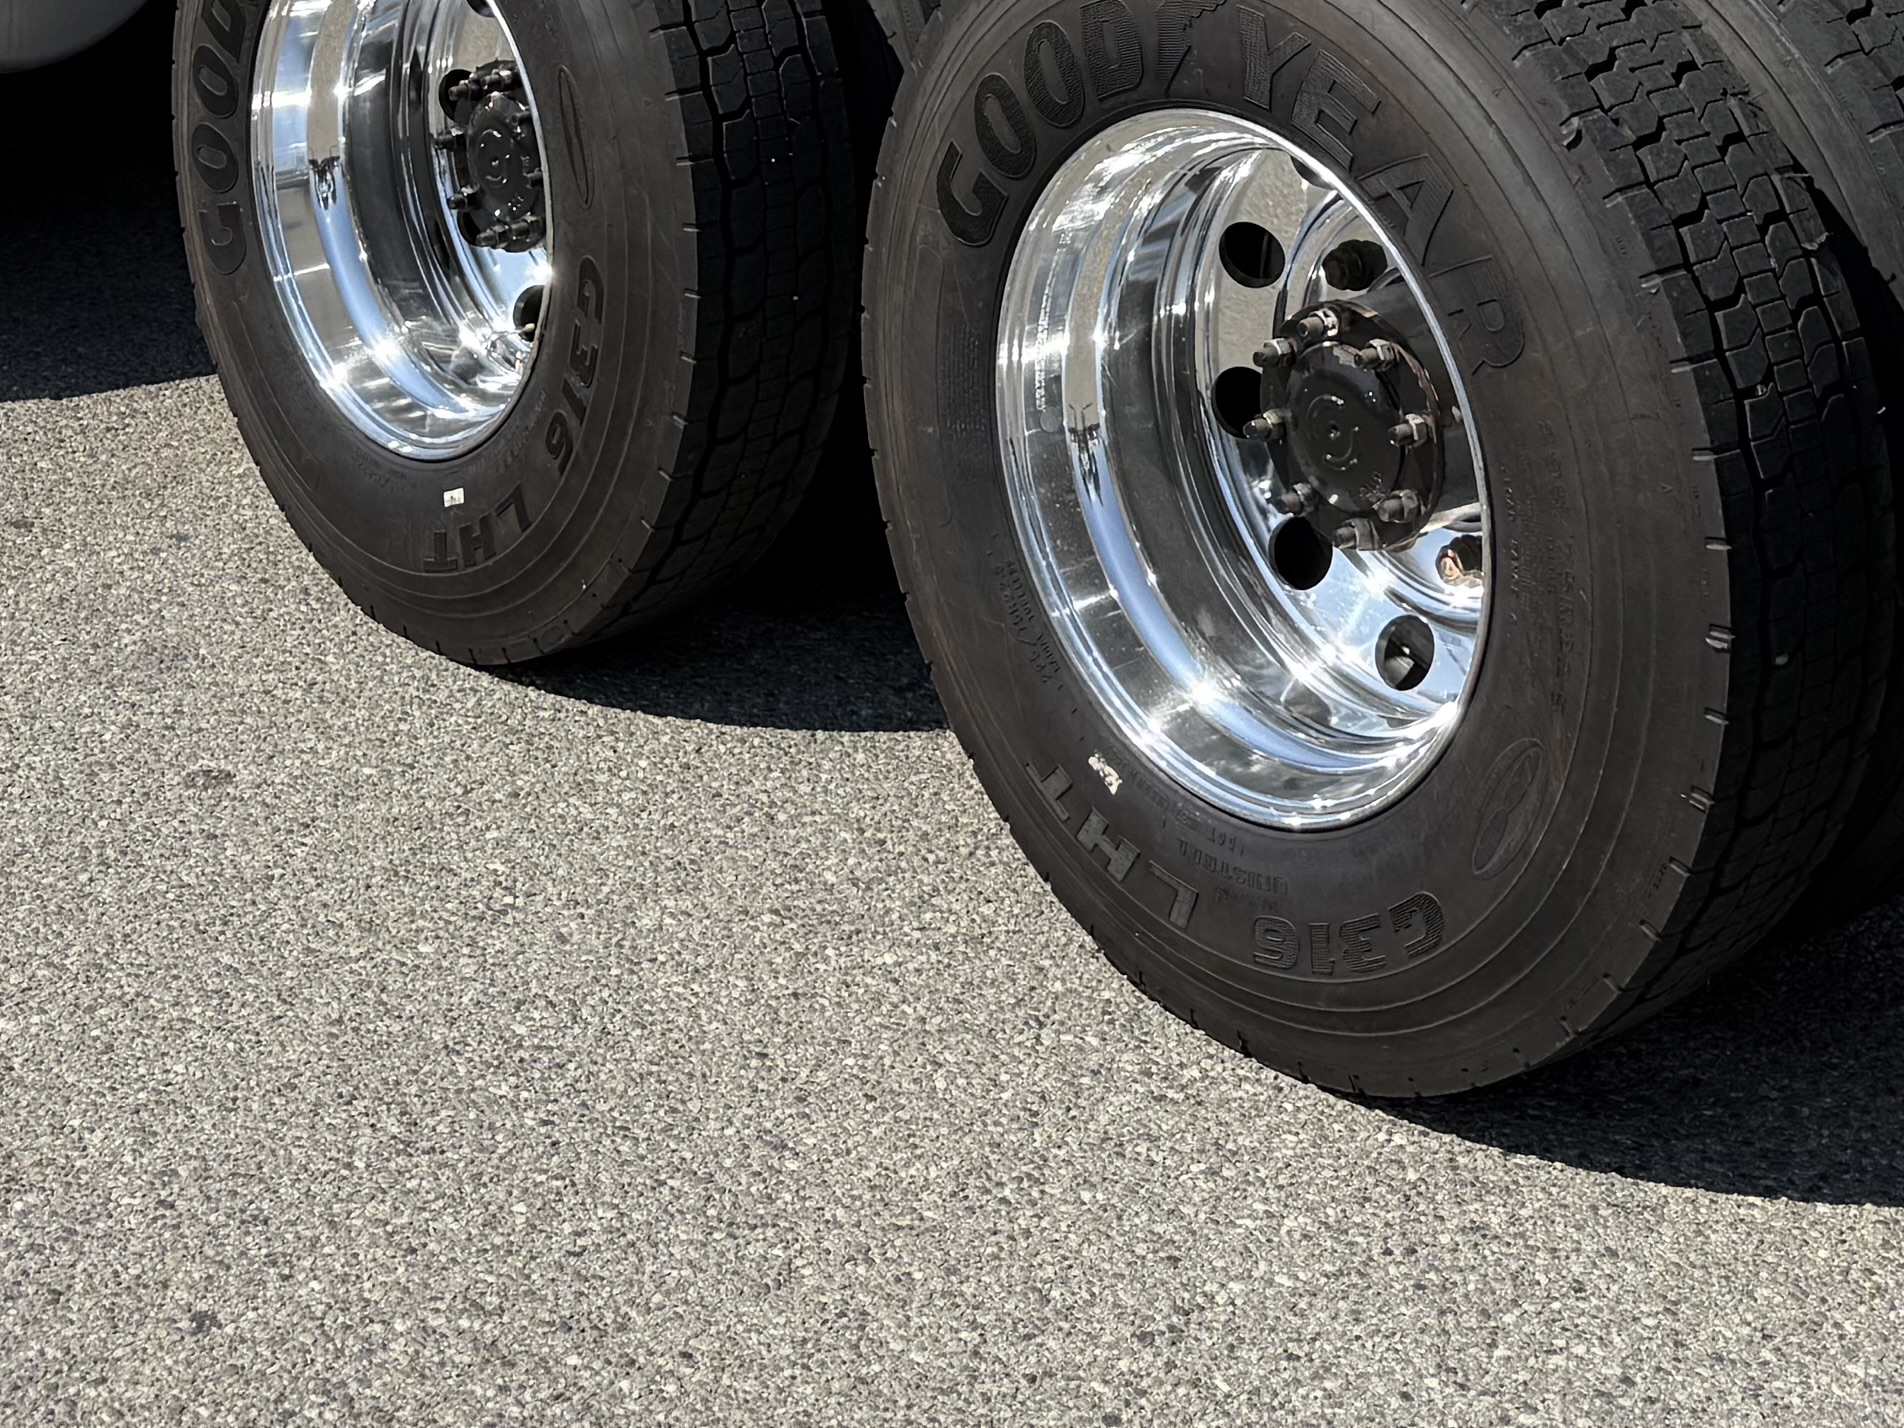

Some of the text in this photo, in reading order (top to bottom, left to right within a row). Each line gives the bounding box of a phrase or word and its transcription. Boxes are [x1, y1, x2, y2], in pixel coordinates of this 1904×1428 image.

[423, 499, 533, 575] LHT
[1023, 757, 1445, 976] G316 LHT
